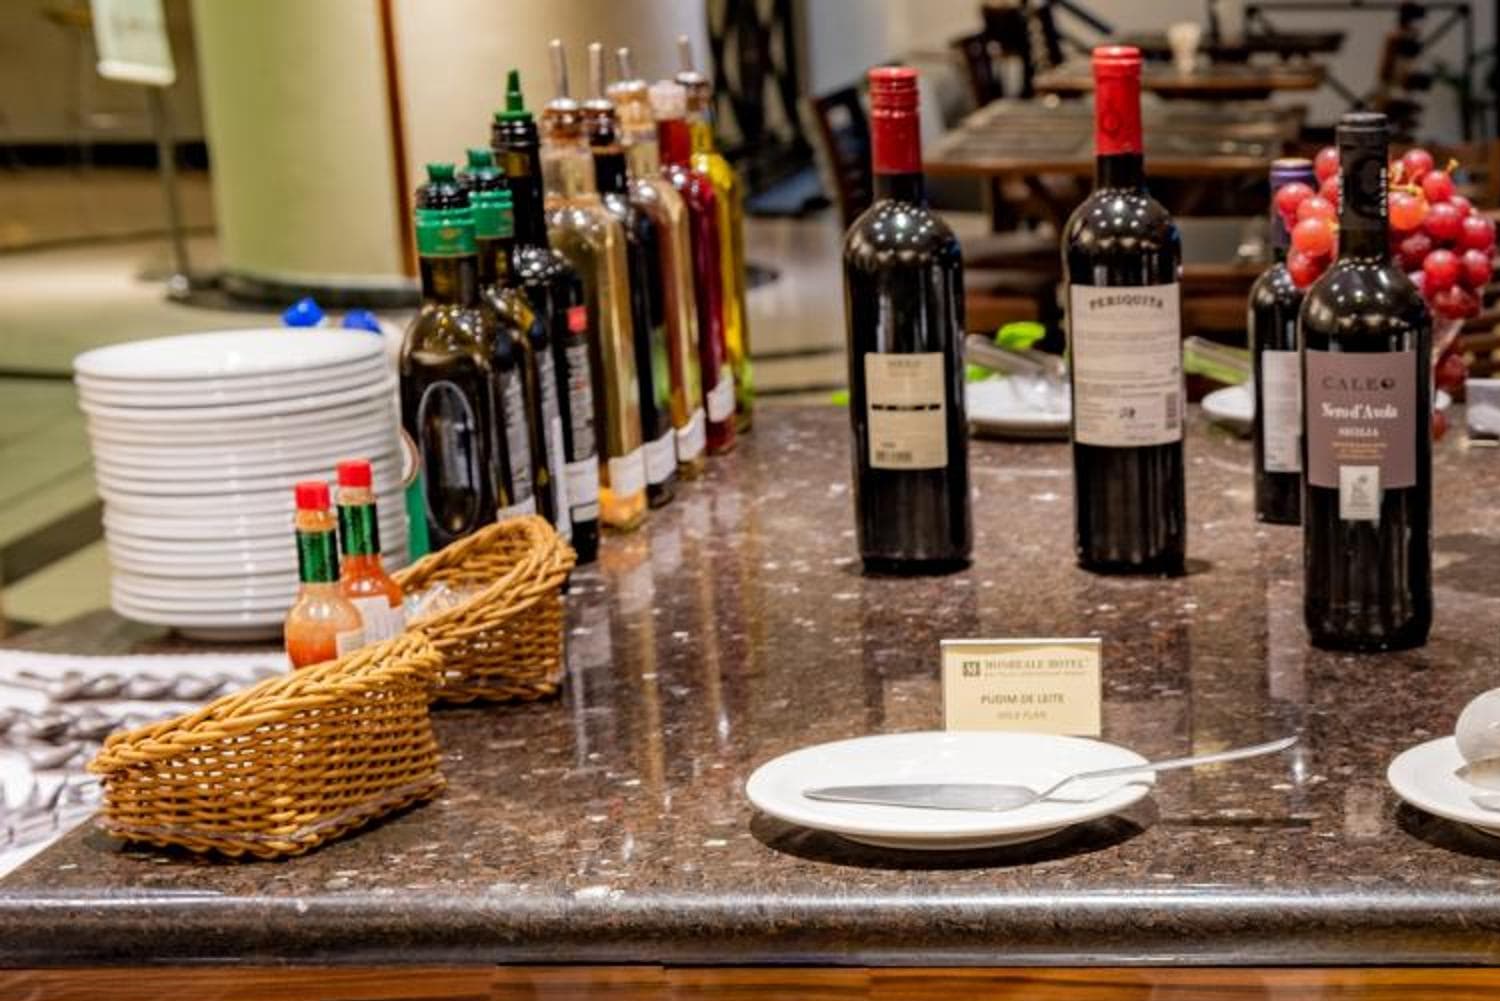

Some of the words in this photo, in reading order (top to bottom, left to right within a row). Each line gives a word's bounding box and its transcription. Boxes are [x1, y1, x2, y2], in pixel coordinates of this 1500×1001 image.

[1090, 294, 1163, 310] PERIQUITA
[1321, 375, 1396, 391] CALEO
[980, 694, 1018, 704] PUDIM
[1020, 694, 1035, 704] DE
